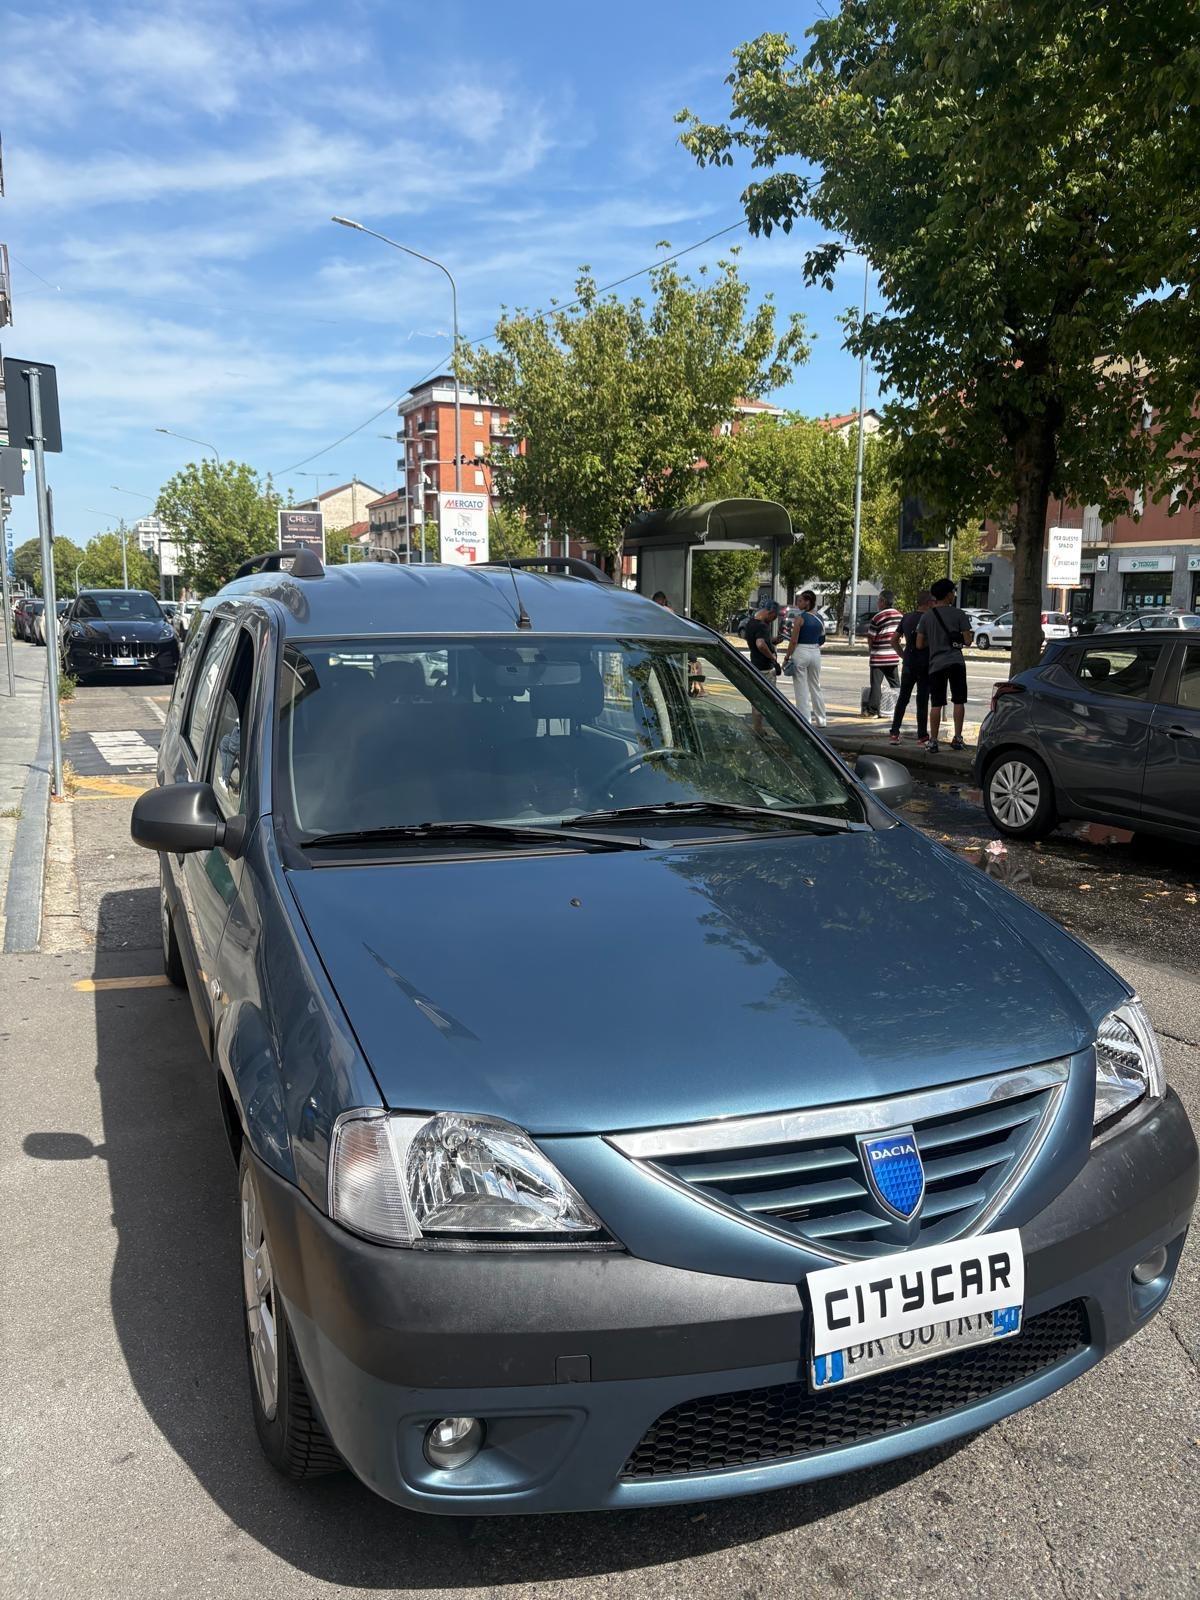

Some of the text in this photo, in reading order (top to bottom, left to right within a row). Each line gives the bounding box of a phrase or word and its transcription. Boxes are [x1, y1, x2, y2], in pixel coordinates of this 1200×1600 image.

[445, 499, 483, 508] MERCATO
[453, 528, 477, 536] Torino
[870, 1144, 916, 1160] DACIA
[825, 1251, 1011, 1331] CITYCAR
